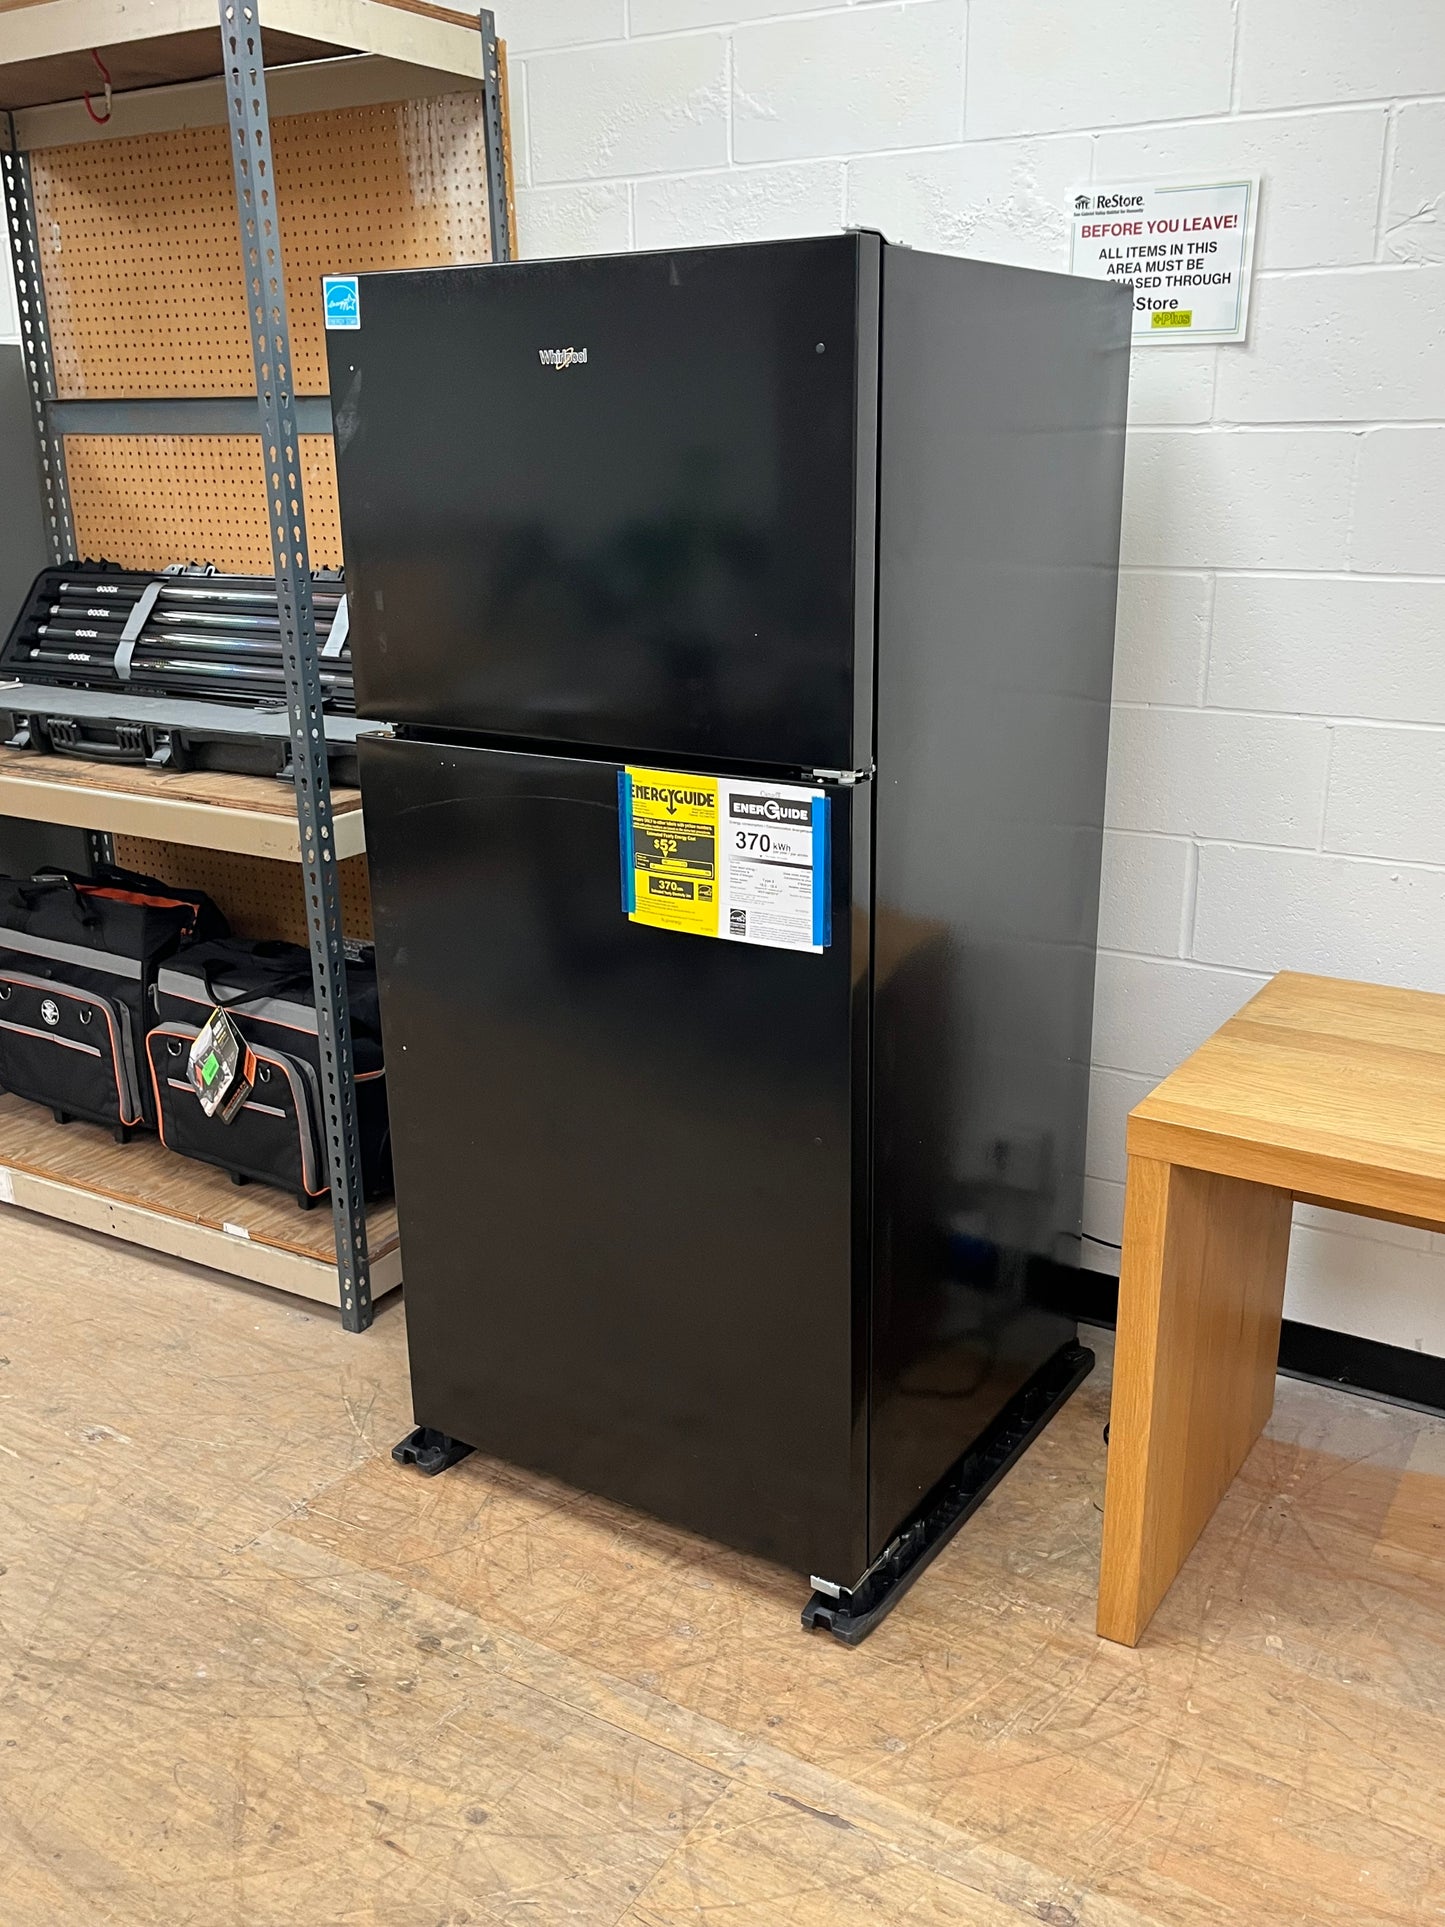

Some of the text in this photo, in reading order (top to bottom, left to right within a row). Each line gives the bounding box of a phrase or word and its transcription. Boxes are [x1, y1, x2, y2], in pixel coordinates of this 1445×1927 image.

[1097, 194, 1143, 209] ReStore
[1081, 214, 1238, 238] BEFORE YOU LEAVE!
[1099, 241, 1218, 260] ALL ITEMS IN THIS
[1106, 258, 1205, 275] AREA MUST BE
[1165, 272, 1232, 287] THROUGH
[1133, 296, 1179, 311] Store
[539, 347, 587, 370] Whirlpool
[654, 837, 678, 852] $52
[735, 831, 792, 853] 370 kWh
[658, 880, 678, 891] 370
